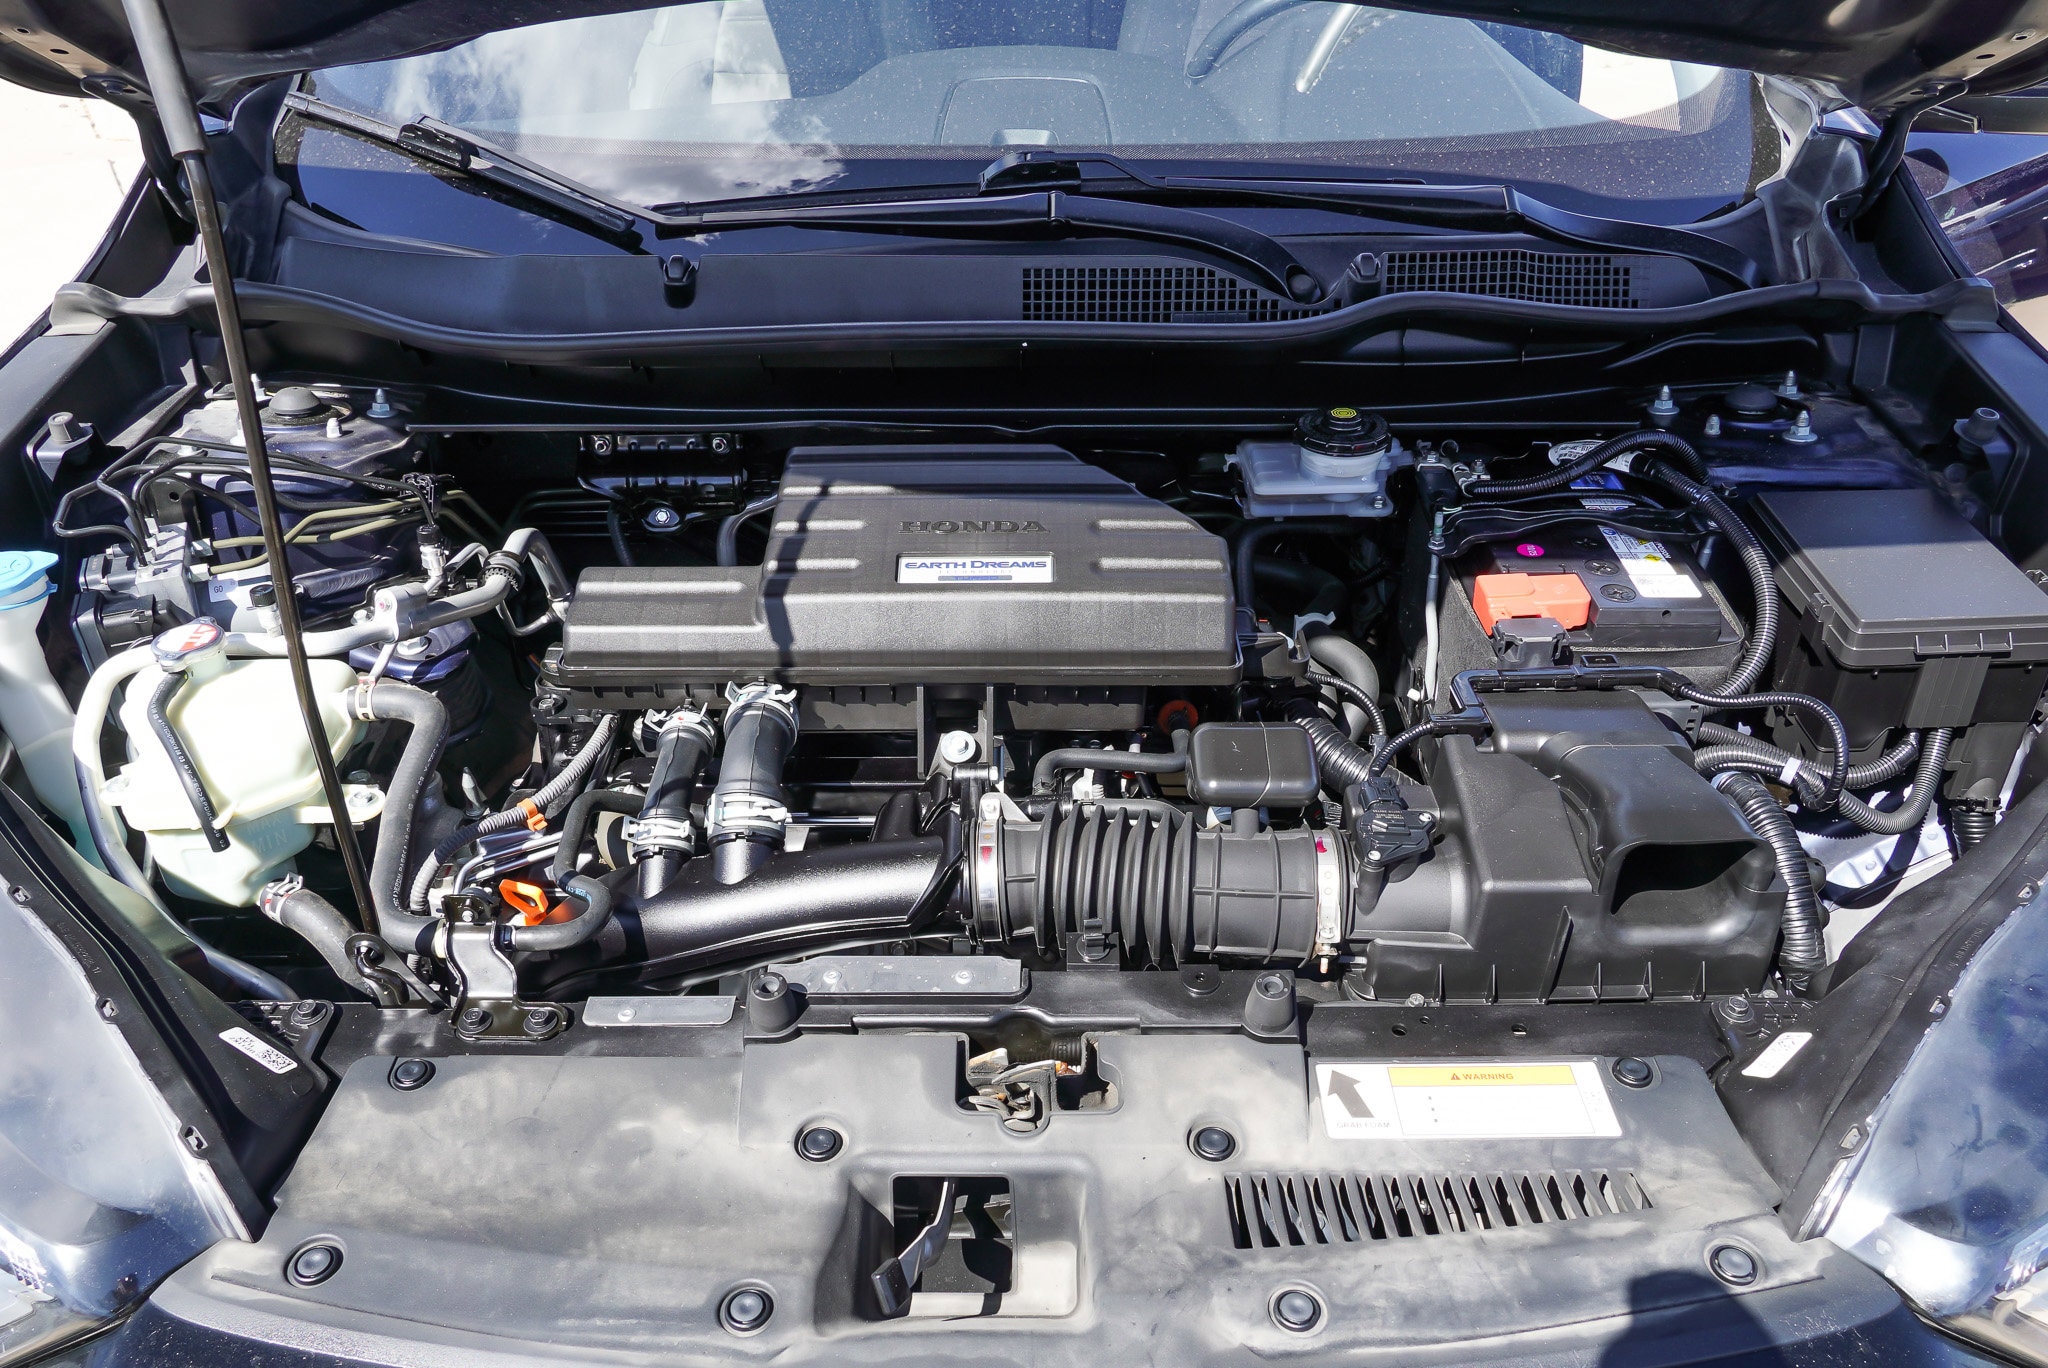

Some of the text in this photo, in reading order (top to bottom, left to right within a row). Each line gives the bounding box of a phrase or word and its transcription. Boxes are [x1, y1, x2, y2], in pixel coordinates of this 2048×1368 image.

[899, 520, 1050, 534] HONDA
[905, 560, 1047, 569] EARTH DREAMS
